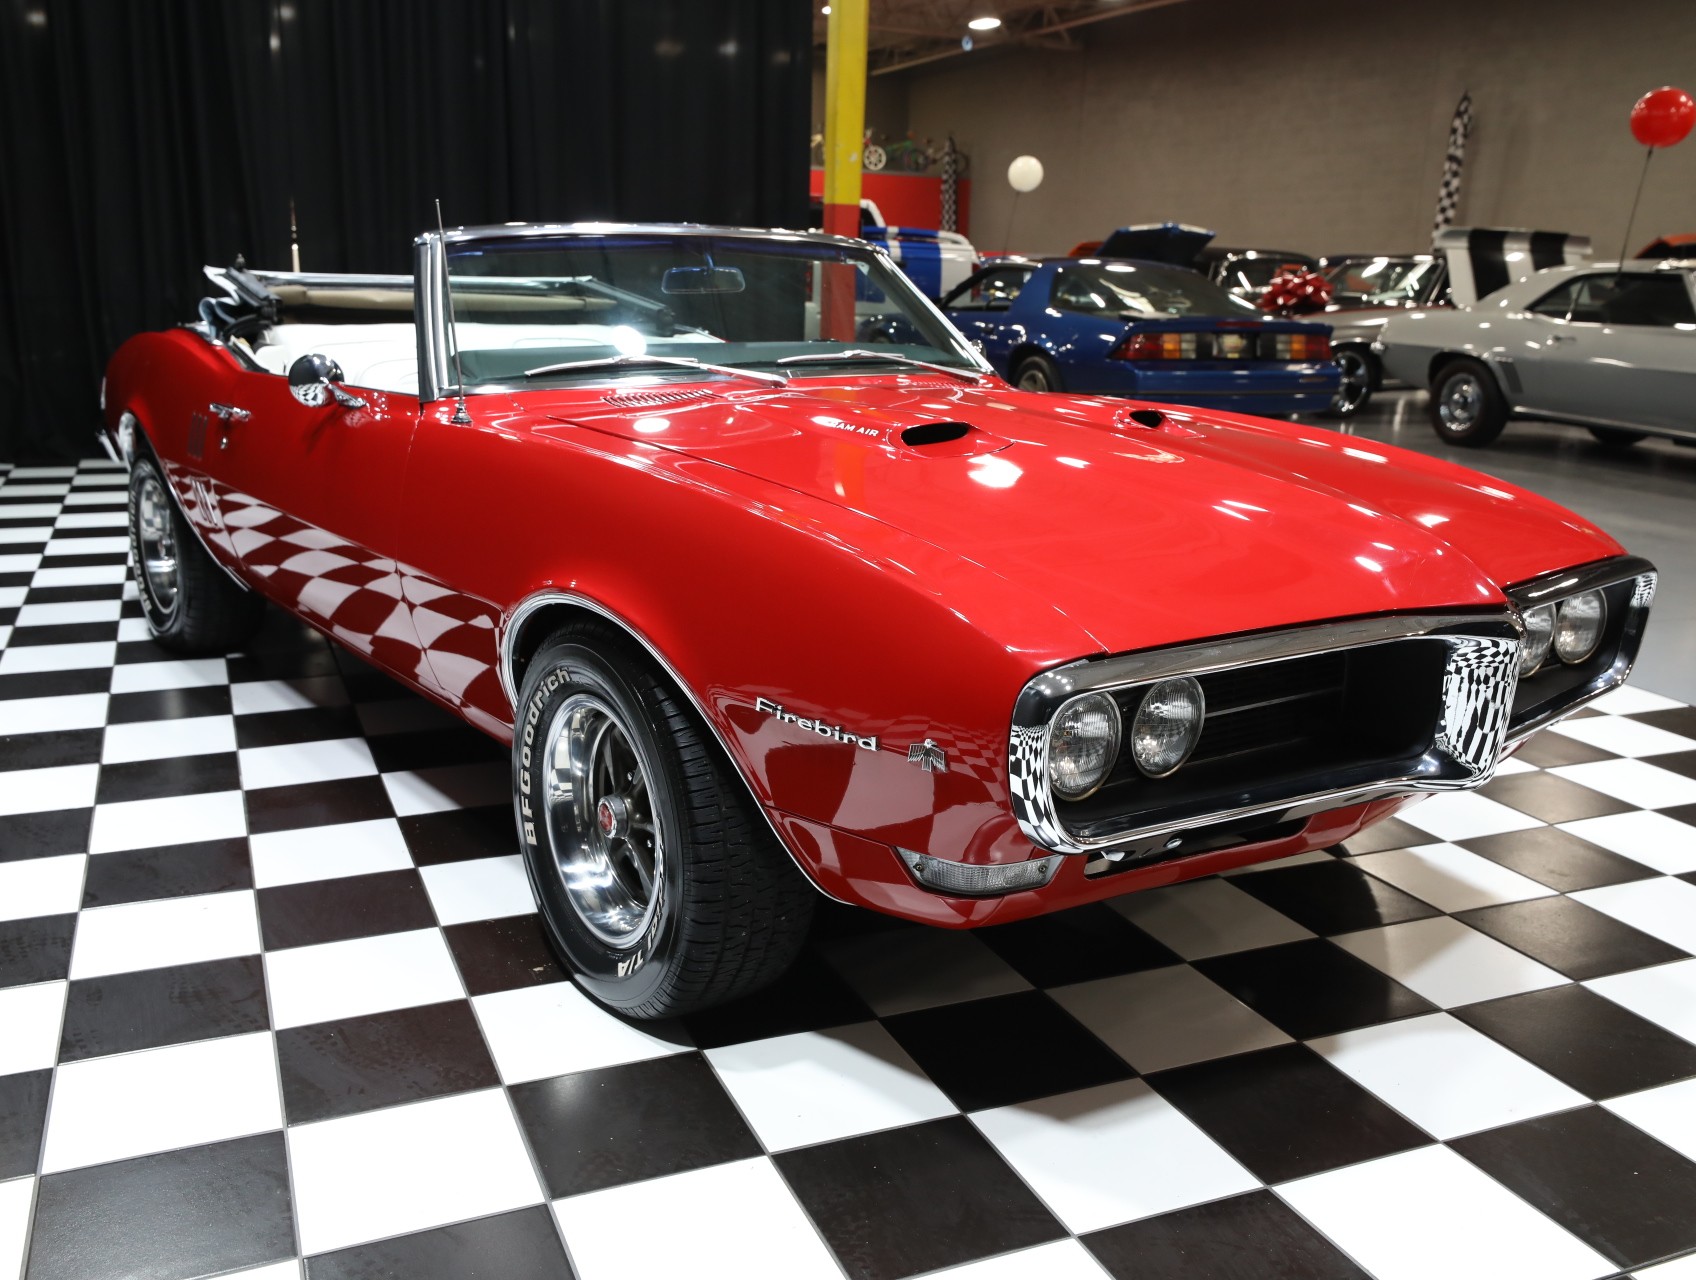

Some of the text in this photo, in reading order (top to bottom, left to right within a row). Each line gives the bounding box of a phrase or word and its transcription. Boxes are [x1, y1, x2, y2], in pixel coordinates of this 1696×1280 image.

[856, 427, 879, 437] AIR
[755, 696, 880, 751] Firebird
[520, 668, 571, 846] BFGoodrich
[617, 949, 644, 978] T/A
